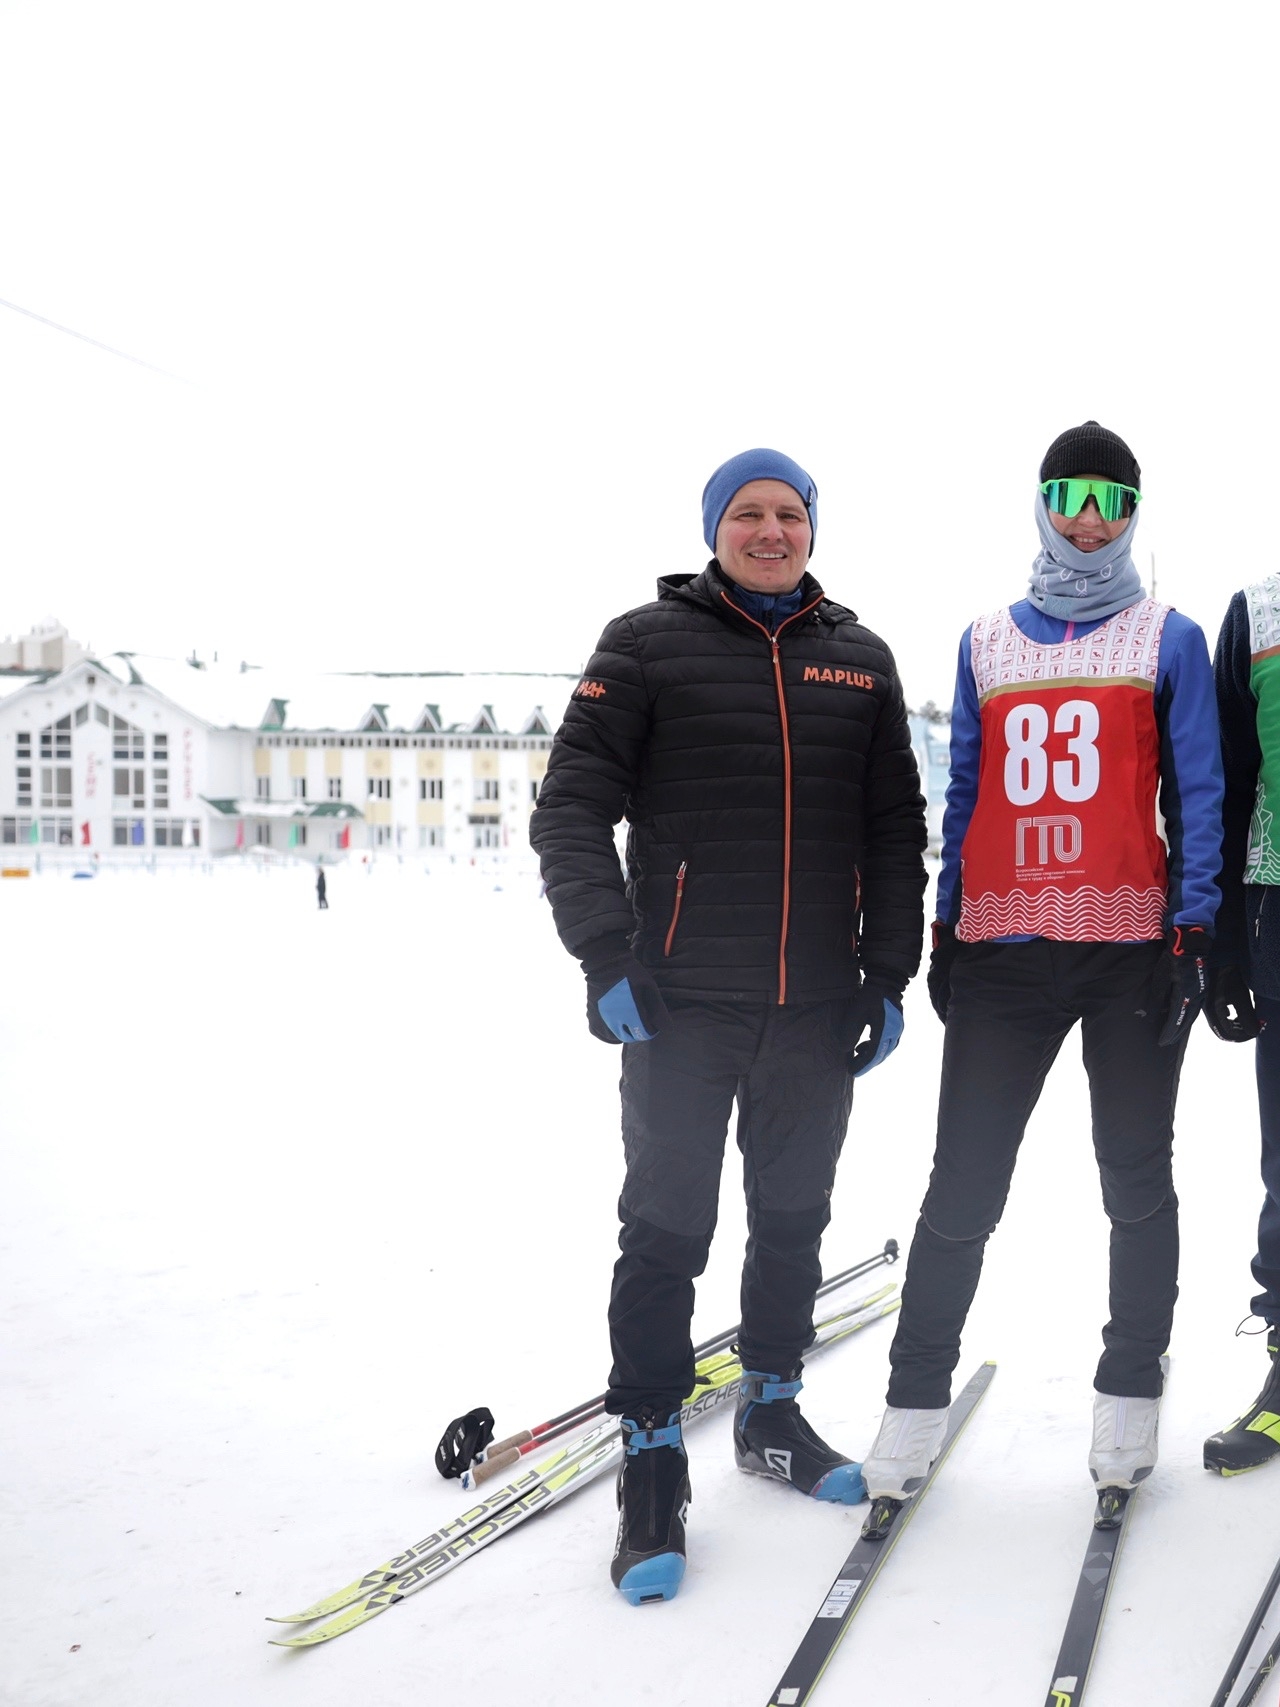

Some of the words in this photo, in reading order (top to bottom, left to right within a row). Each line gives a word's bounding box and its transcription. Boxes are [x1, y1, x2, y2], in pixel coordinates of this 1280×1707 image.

[803, 666, 873, 689] MAPLUS
[1004, 699, 1100, 806] 83
[1015, 814, 1082, 866] ГТО
[681, 1384, 740, 1423] FISCHE
[390, 1469, 541, 1570] FISCHER
[397, 1485, 552, 1590] FISCHER
